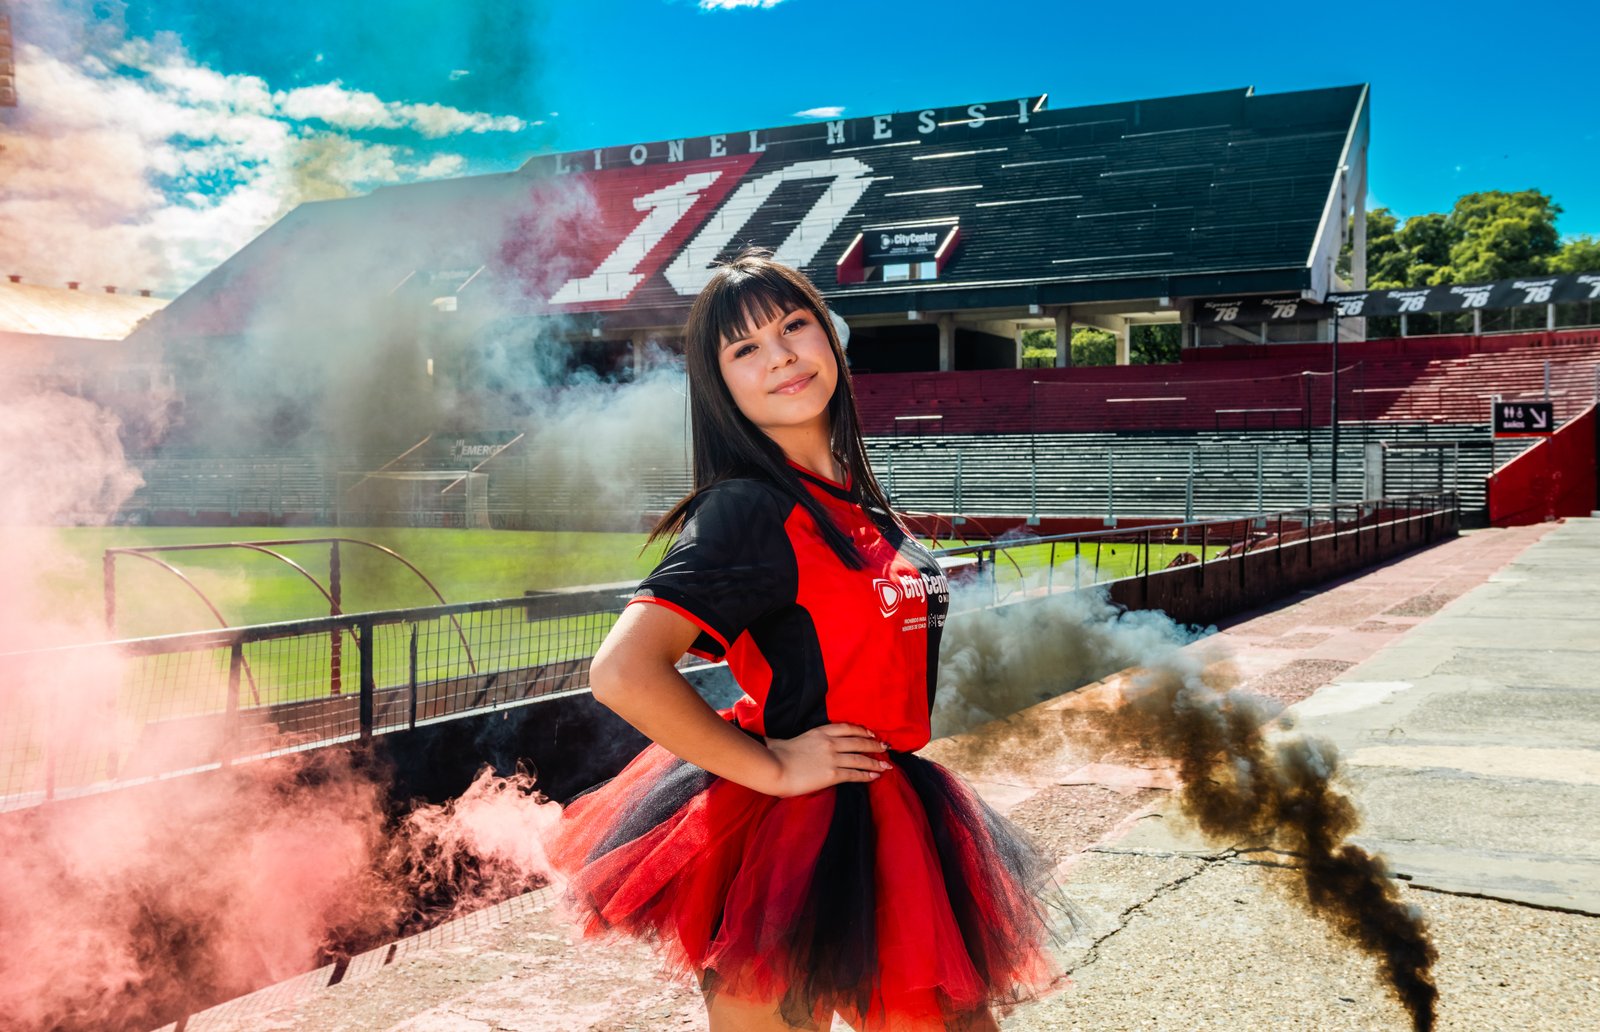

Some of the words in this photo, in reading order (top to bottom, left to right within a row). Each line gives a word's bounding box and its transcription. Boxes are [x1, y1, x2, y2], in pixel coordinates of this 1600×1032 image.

[555, 130, 767, 175] LIONEL
[826, 99, 1029, 145] MESSI
[548, 156, 874, 304] 10
[1450, 285, 1495, 294] Sport
[1512, 279, 1557, 289] Sport
[1387, 290, 1431, 299] Sport
[1461, 291, 1491, 309] 78
[1523, 286, 1553, 304] 78
[1271, 303, 1298, 320] 78
[1339, 300, 1365, 317] 78
[1398, 295, 1427, 313] 78
[1214, 307, 1239, 322] 78
